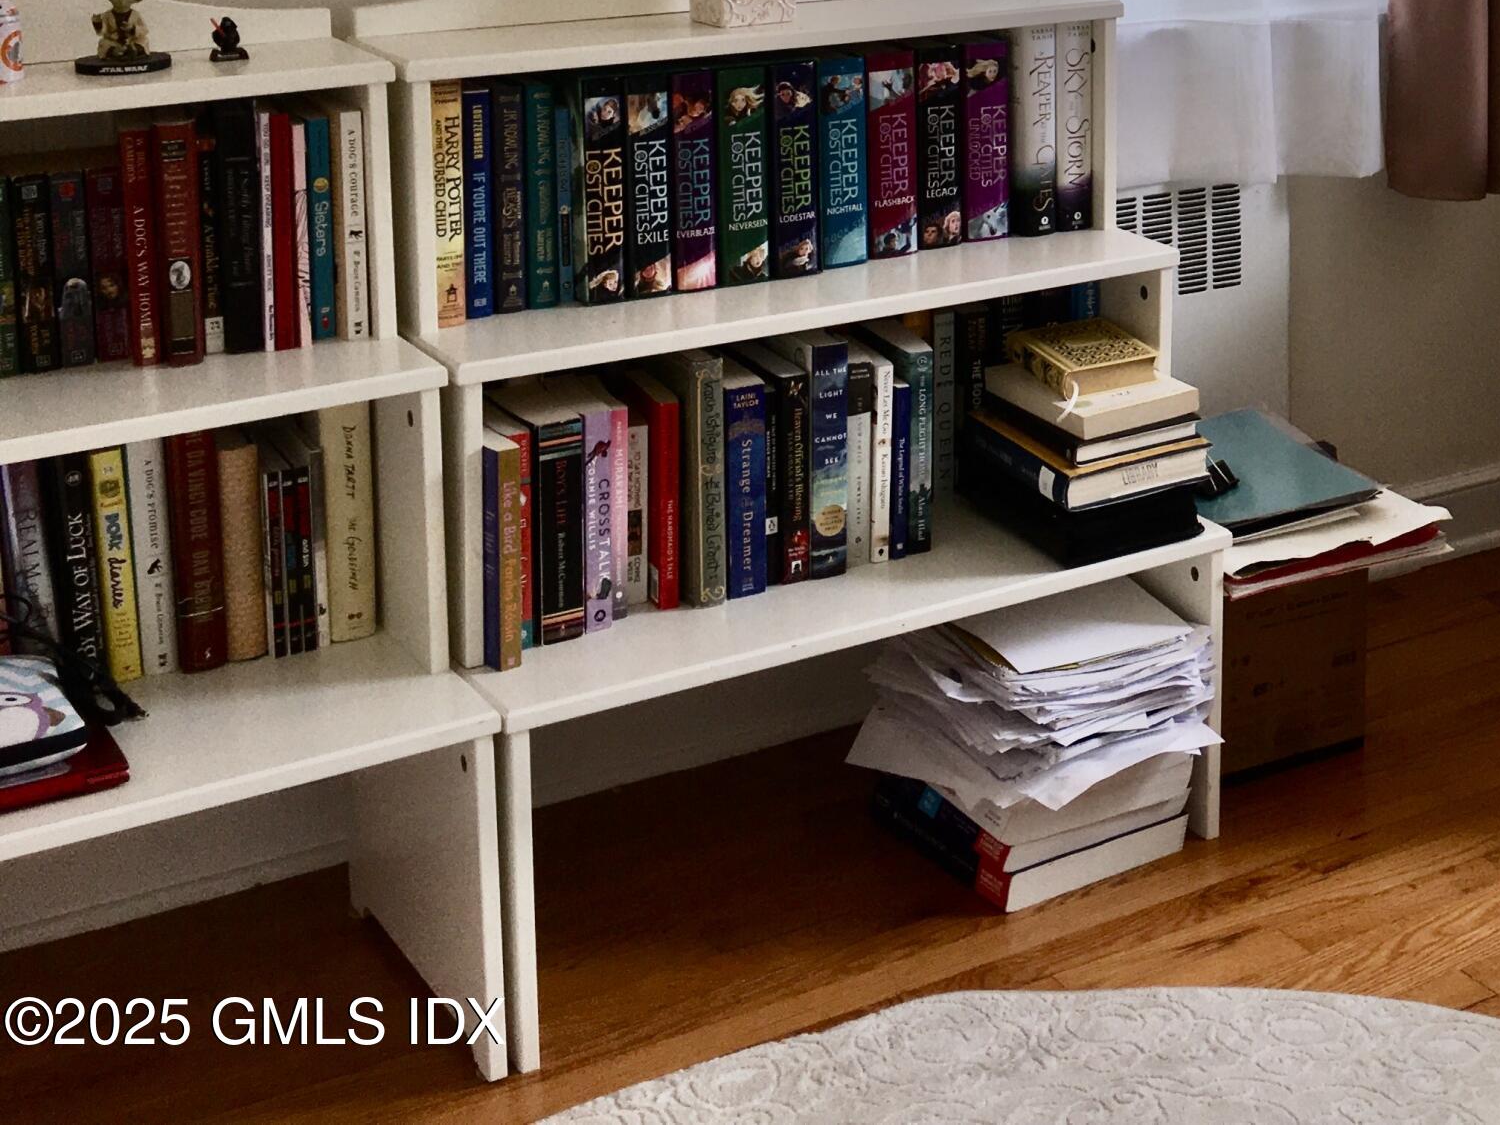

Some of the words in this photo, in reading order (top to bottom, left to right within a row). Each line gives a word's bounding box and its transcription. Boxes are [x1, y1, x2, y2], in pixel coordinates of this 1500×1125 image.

[125, 65, 148, 73] WARS
[1063, 48, 1089, 100] SKY
[1030, 55, 1054, 128] REAPER
[536, 120, 550, 164] ROWLING
[829, 120, 842, 158] LOST
[879, 115, 892, 152] LOST
[927, 106, 940, 143] LOST
[980, 106, 992, 141] LOST
[444, 116, 460, 171] HARRY
[504, 124, 518, 169] ROWLING
[678, 140, 693, 180] LOST
[731, 134, 746, 172] LOST
[780, 127, 794, 165] LOST
[841, 118, 859, 203] KEEPER
[892, 113, 908, 195] KEEPER
[939, 105, 955, 187] KEEPER
[968, 118, 981, 181] UNLOCKED
[992, 104, 1006, 183] KEEPER
[1063, 116, 1089, 193] STORM
[434, 152, 445, 198] CURSED
[472, 173, 485, 184] IF
[585, 150, 602, 198] LOST
[634, 142, 649, 186] LOST
[693, 138, 711, 225] KEEPER
[745, 131, 763, 218] KEEPER
[793, 125, 811, 209] KEEPER
[879, 154, 893, 199] CITIES
[927, 145, 940, 189] CITIES
[981, 144, 993, 187] CITIES
[1032, 145, 1054, 212] GATES
[602, 147, 623, 252] KEEPER
[648, 139, 668, 231] KEEPER
[731, 175, 747, 222] CITIES
[781, 168, 794, 214] CITIES
[829, 161, 843, 207] CITIES
[874, 196, 915, 208] FLASHBACK
[926, 187, 958, 198] LEGACY
[133, 205, 144, 214] A
[435, 201, 447, 238] CHILD
[446, 177, 462, 242] POTTER
[472, 186, 485, 224] YOU'RE
[635, 188, 650, 233] CITIES
[679, 183, 694, 229] CITIES
[778, 211, 815, 223] LODESTAR
[826, 203, 863, 215] NIGHTFALL
[133, 219, 147, 257] DOG'S
[314, 201, 329, 257] Sisters
[473, 227, 485, 248] OUT
[587, 199, 603, 256] CITIES
[637, 231, 669, 245] EXILE
[728, 219, 768, 231] NEVERSEEN
[204, 233, 219, 273] Wrinkle
[474, 251, 486, 284] THERE
[137, 262, 149, 287] WAY
[138, 293, 152, 329] HOME
[831, 367, 846, 376] THE
[939, 337, 953, 376] RED
[882, 371, 890, 393] Never
[918, 388, 927, 414] LONG
[792, 407, 803, 441] Heaven
[882, 407, 889, 421] Me
[882, 422, 889, 435] Go
[342, 425, 357, 459] DONNA
[814, 432, 847, 444] CANNOT
[898, 437, 906, 448] The
[918, 417, 927, 450] FLIGHT
[937, 402, 952, 482] QUEEN
[186, 451, 204, 469] DA
[614, 449, 624, 509] MURAKAMI
[739, 439, 752, 494] Strange
[824, 457, 839, 465] SEE
[896, 450, 905, 470] Legend
[918, 452, 928, 480] HOME
[188, 470, 206, 504] VINCI
[344, 464, 356, 500] TARTT
[502, 481, 515, 508] Like
[588, 461, 597, 505] CONNIE
[503, 512, 513, 522] a
[792, 484, 804, 522] Blessing
[66, 514, 86, 562] LUCK
[191, 509, 208, 540] CODE
[503, 526, 517, 555] Bird
[588, 510, 597, 551] WILLIS
[666, 516, 674, 562] HANDMAID'S
[742, 512, 753, 571] Dreamer
[917, 519, 926, 541] Hlad
[192, 549, 211, 576] DAN
[556, 532, 566, 561] Robert
[73, 565, 89, 586] OF
[107, 557, 127, 608] diaries
[556, 562, 567, 608] McCammon
[666, 563, 674, 580] TALE
[71, 591, 95, 632] WAY
[79, 636, 97, 658] BY
